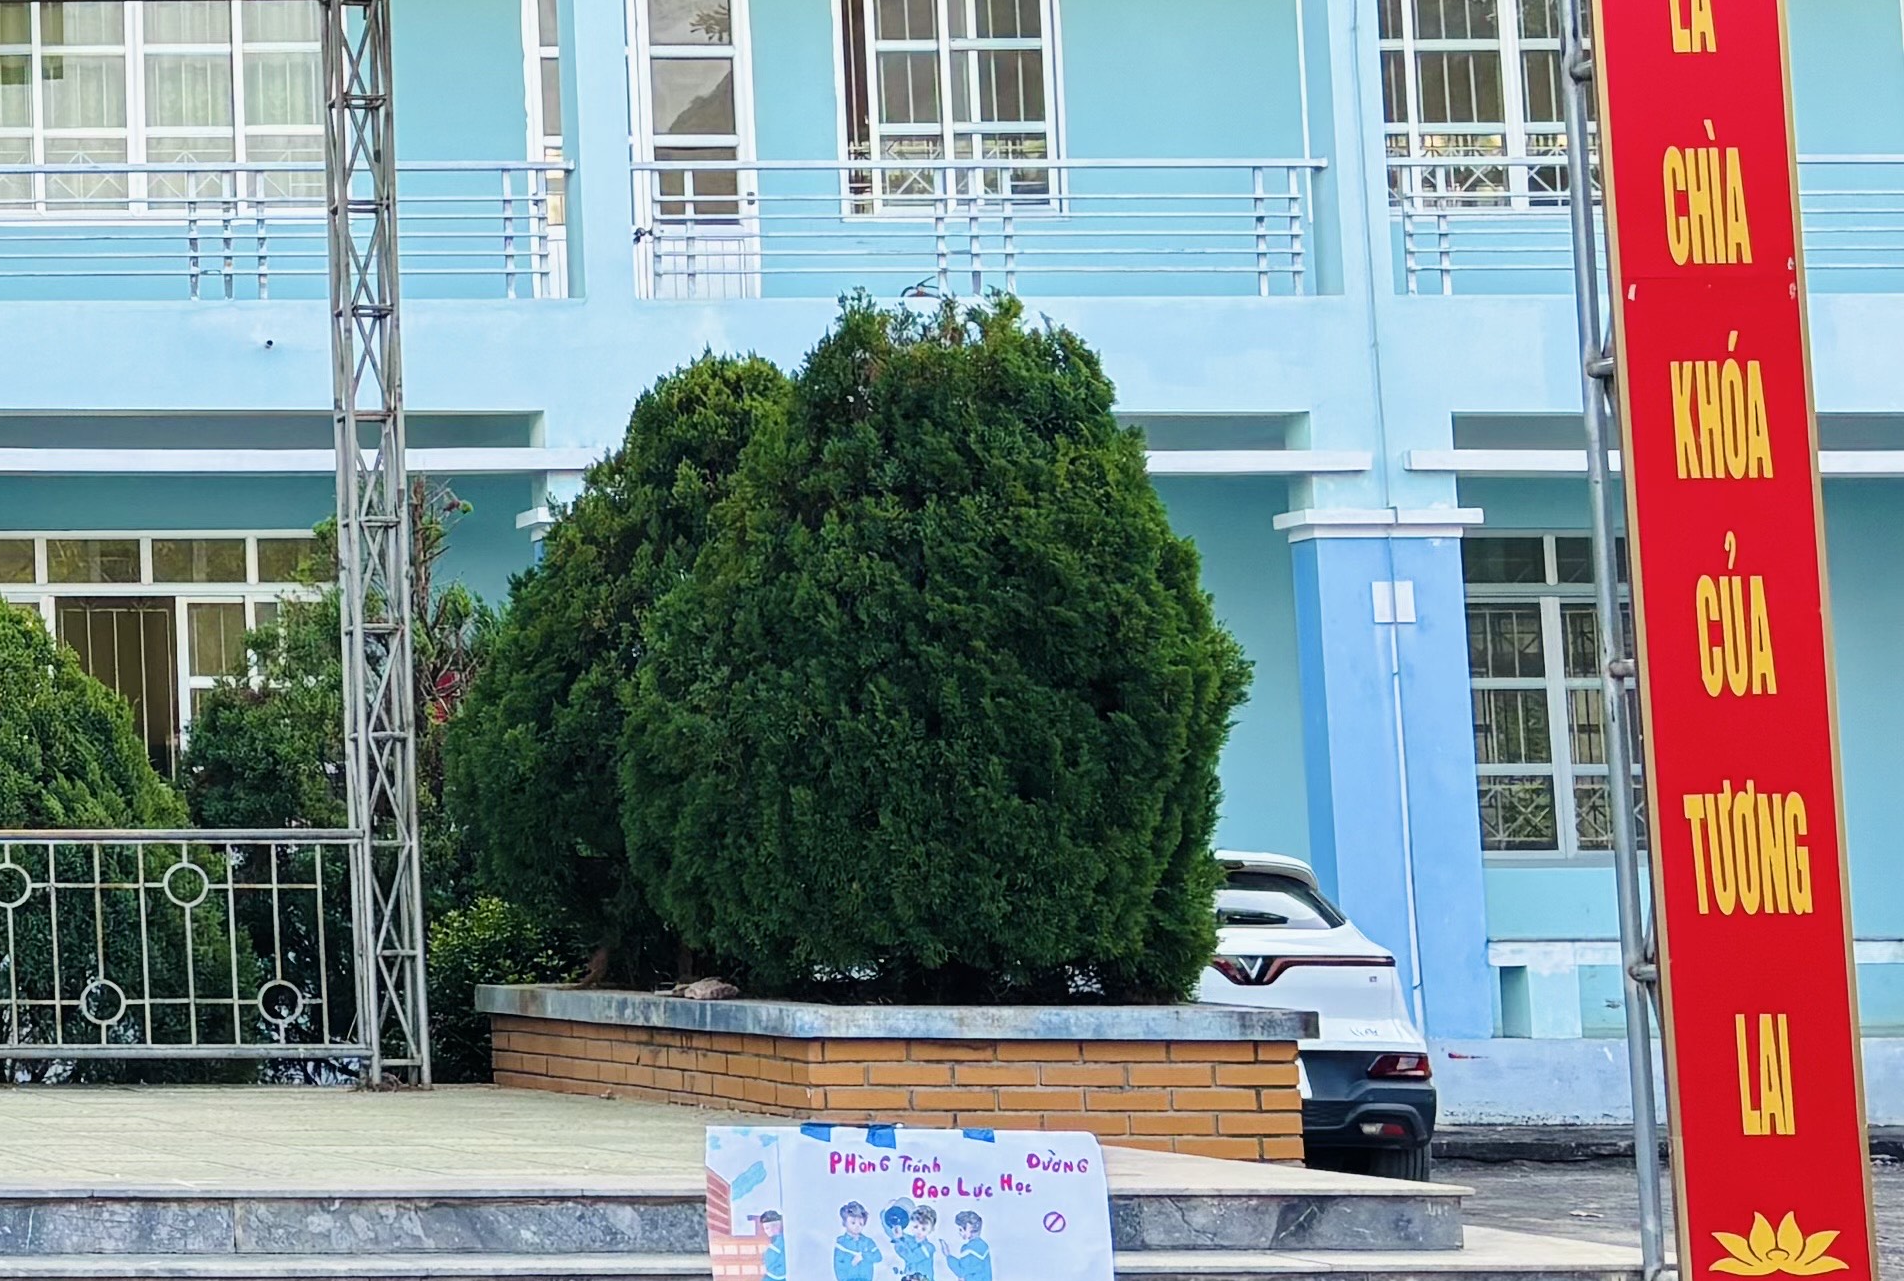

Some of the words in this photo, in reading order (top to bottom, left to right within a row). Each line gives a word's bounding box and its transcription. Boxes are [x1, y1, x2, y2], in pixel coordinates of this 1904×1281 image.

[1662, 118, 1753, 267] CHÌA
[1669, 330, 1775, 480] KHÓA
[1695, 530, 1777, 698] CỦA
[1683, 779, 1814, 916] TƯƠNG
[1734, 1013, 1796, 1136] LAI
